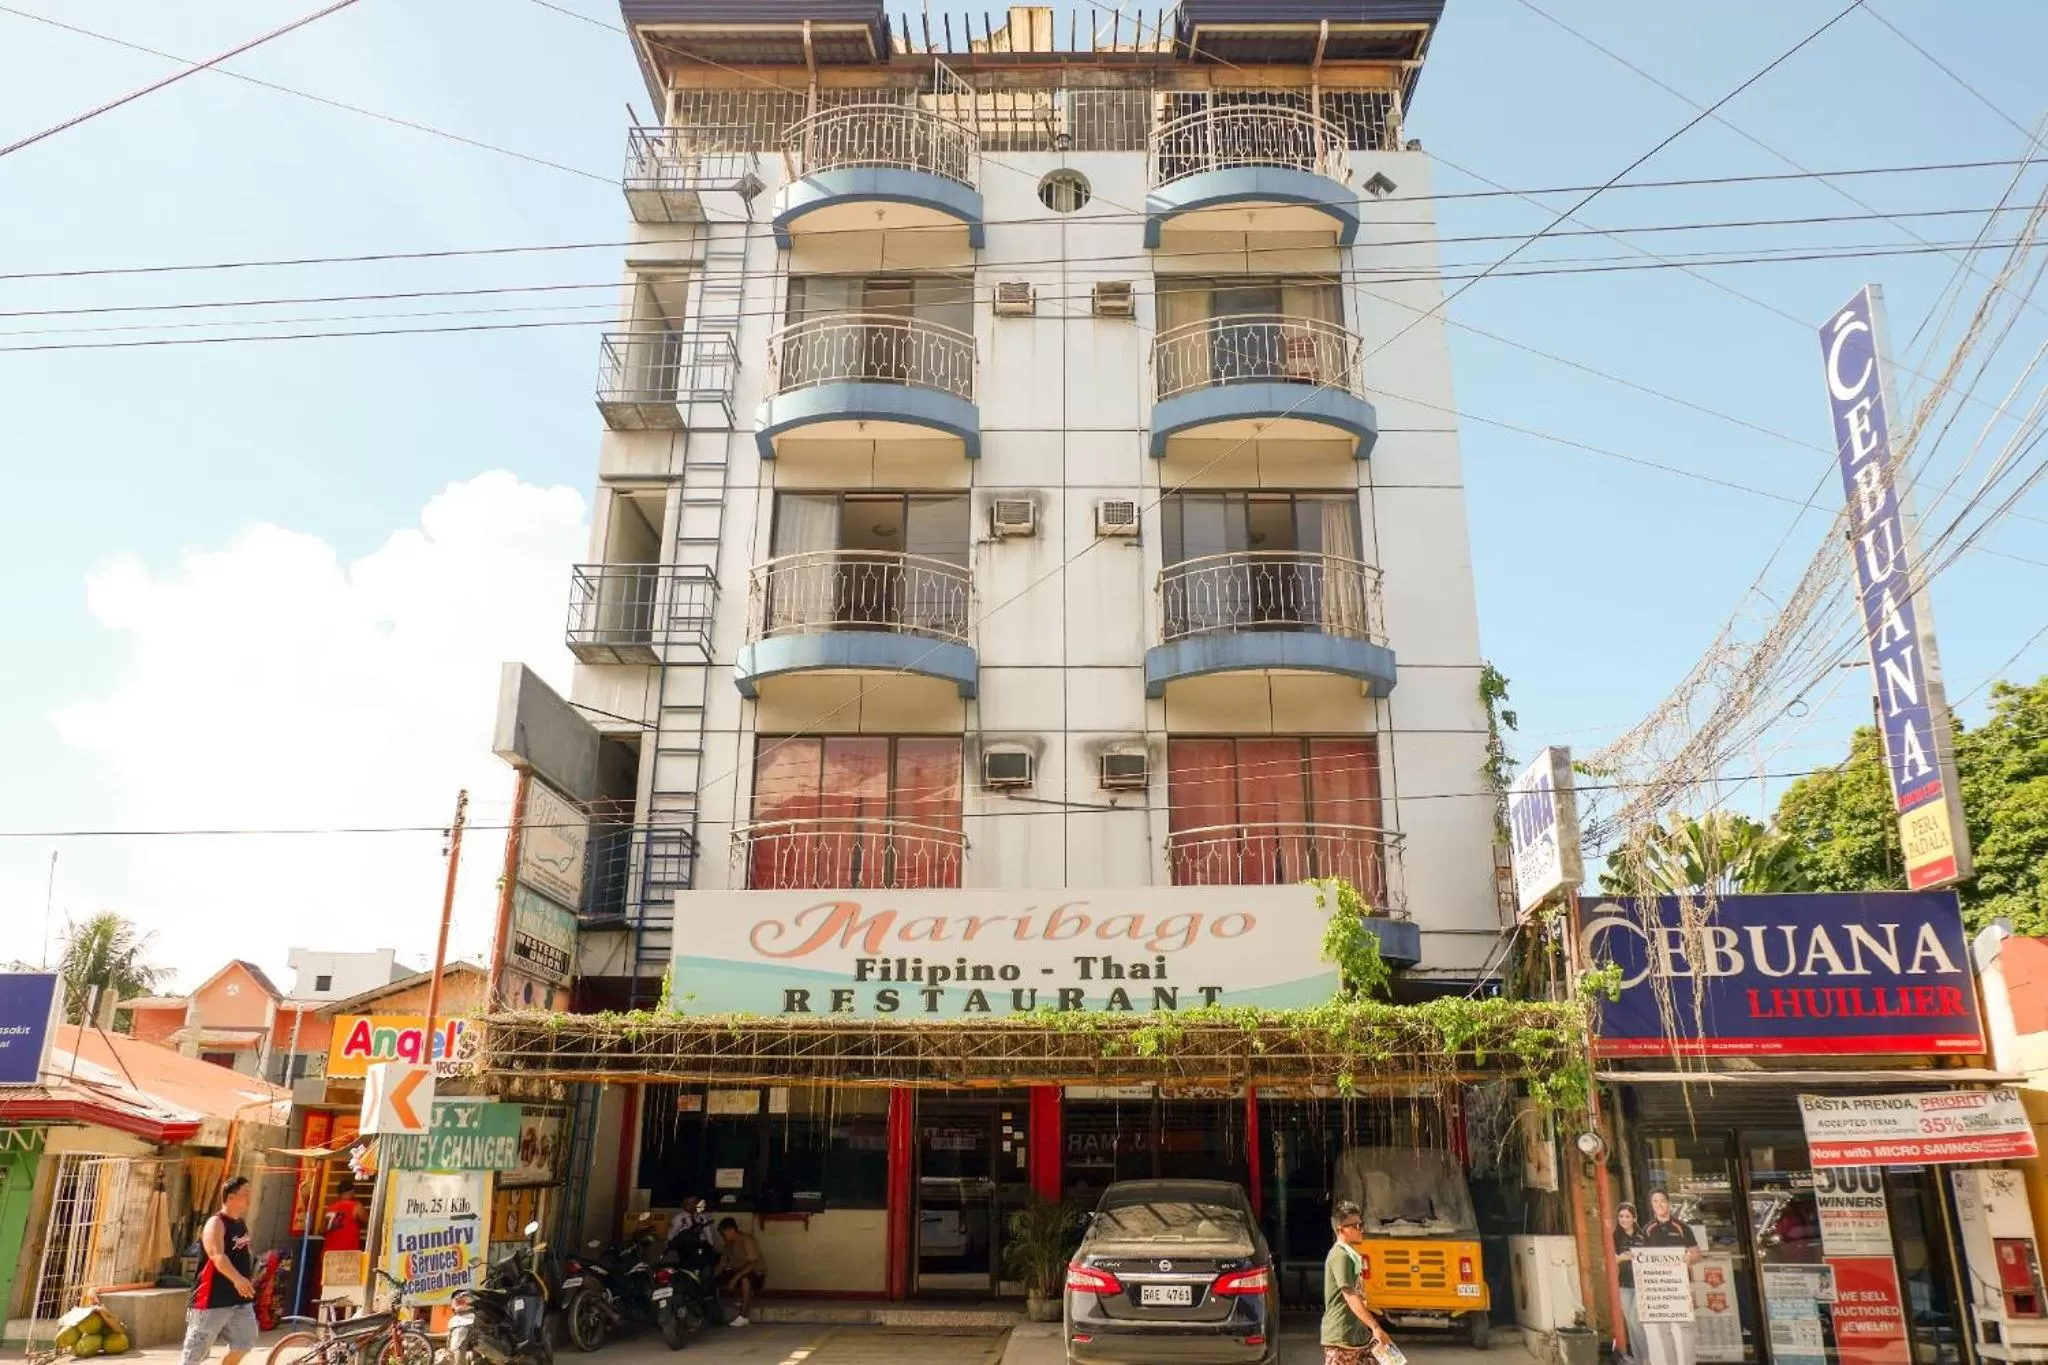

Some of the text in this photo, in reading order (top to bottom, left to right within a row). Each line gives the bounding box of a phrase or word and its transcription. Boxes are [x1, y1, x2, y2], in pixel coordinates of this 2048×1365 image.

[1828, 311, 1933, 785] CEBUANA
[1912, 815, 1939, 838] PERA
[750, 900, 1257, 958] Maribago
[515, 932, 562, 963] WESTERN
[1582, 902, 1962, 989] CEBUANA
[529, 949, 561, 971] UNION
[855, 957, 1021, 986] Filipino
[1074, 955, 1168, 980] Thai
[783, 986, 1223, 1012] RESTAURANT
[1748, 986, 1970, 1018] LHUILLIER
[1804, 1100, 1850, 1111] BASTA
[1920, 1094, 1988, 1107] PRIORITY
[1920, 1117, 1965, 1133] 35%
[391, 1135, 515, 1168] ONEY CHANGER
[1811, 1149, 1841, 1159] Now
[1844, 1147, 1871, 1158] with
[1874, 1145, 1920, 1157] MICRO
[406, 1199, 428, 1218] Php.
[431, 1199, 442, 1213] 25
[450, 1198, 471, 1212] Kilo
[1818, 1196, 1884, 1208] WINNERS
[397, 1226, 474, 1253] Laundry
[411, 1250, 458, 1274] Services
[400, 1265, 471, 1295] ccepted here!
[1839, 1291, 1889, 1301] WE SELL
[1833, 1306, 1899, 1317] AUCTIONED
[1842, 1321, 1895, 1333] JEWELRY
